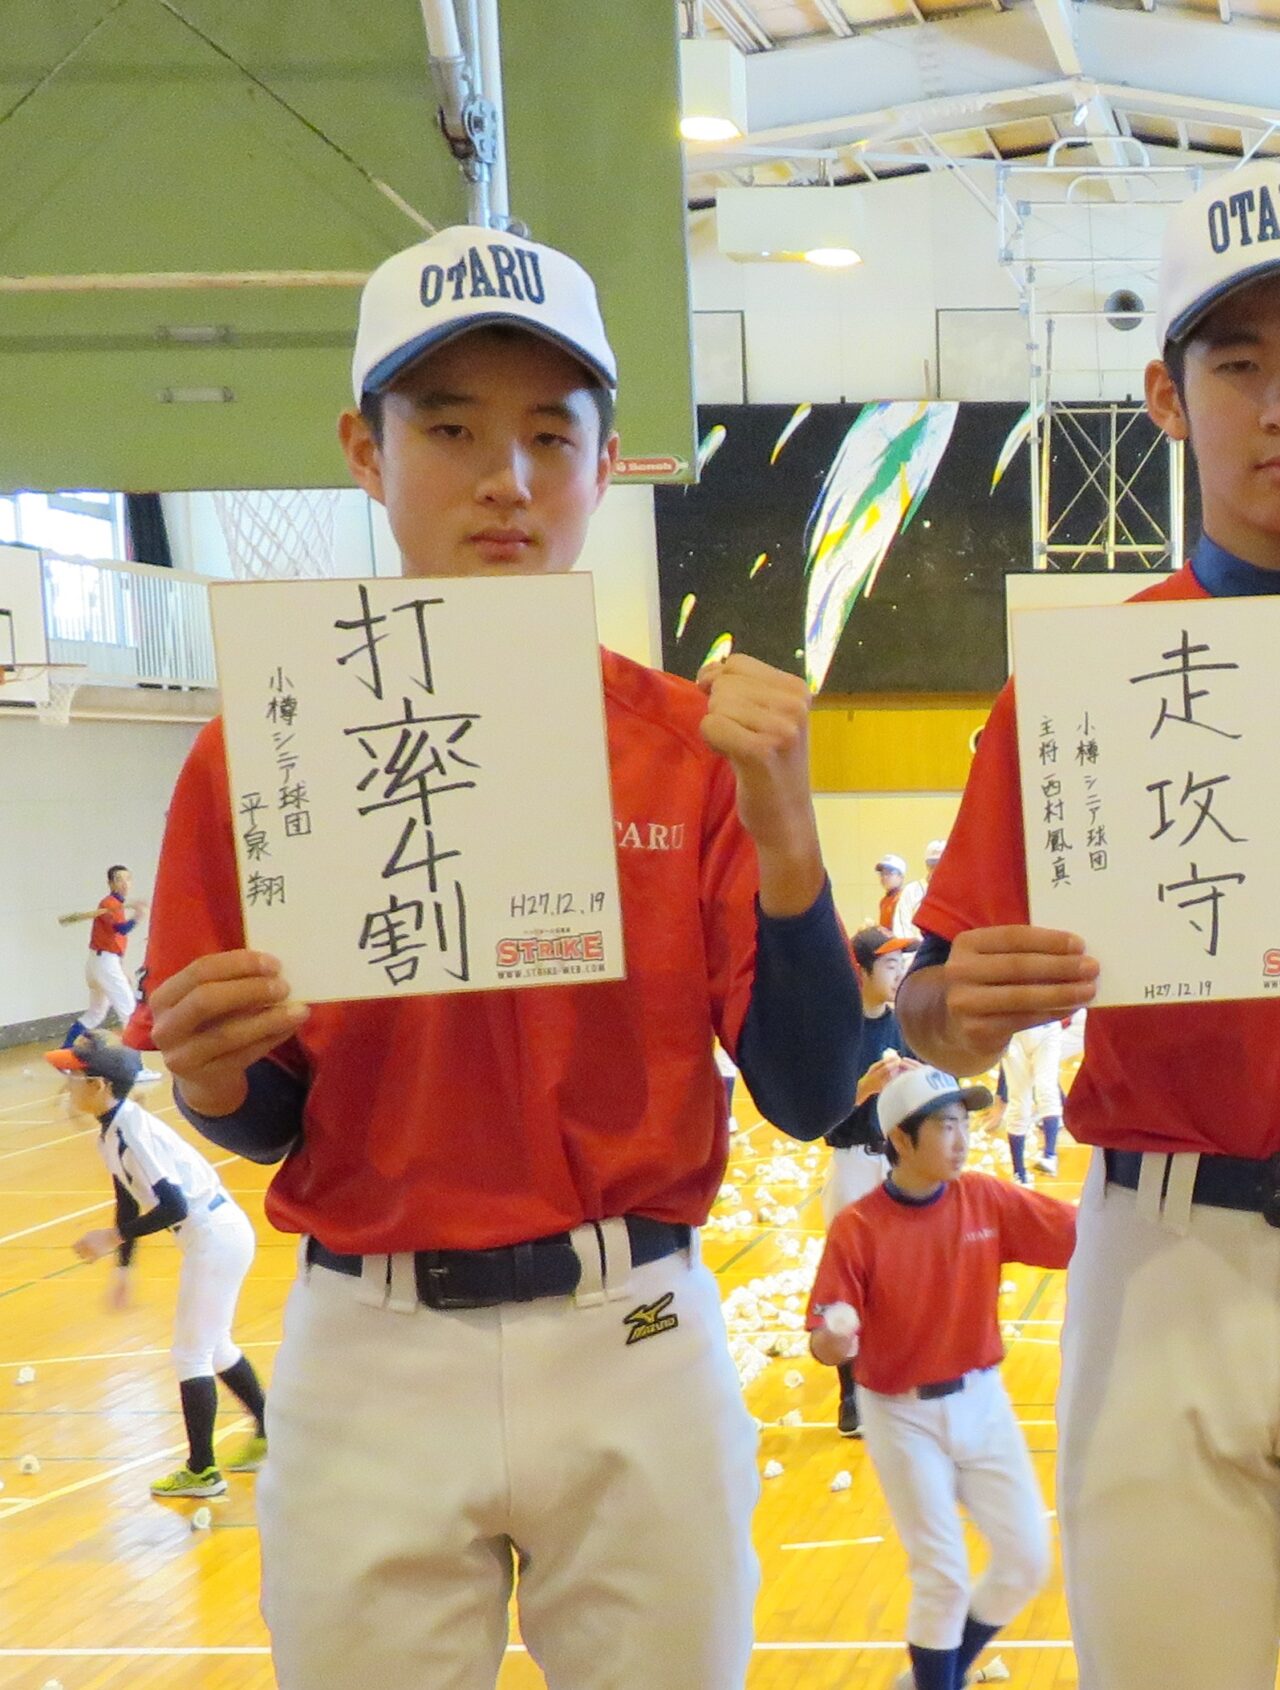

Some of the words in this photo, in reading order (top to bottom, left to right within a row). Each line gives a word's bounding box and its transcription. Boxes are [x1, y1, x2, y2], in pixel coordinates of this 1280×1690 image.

[419, 245, 545, 307] OTARU
[265, 666, 312, 838] 小樽シニア球団
[334, 584, 482, 986] 打率4割
[1075, 711, 1109, 872] 小樽シニア球団
[1128, 629, 1248, 956] 走攻守
[614, 821, 685, 850] ARU
[496, 931, 604, 966] STRIKE
